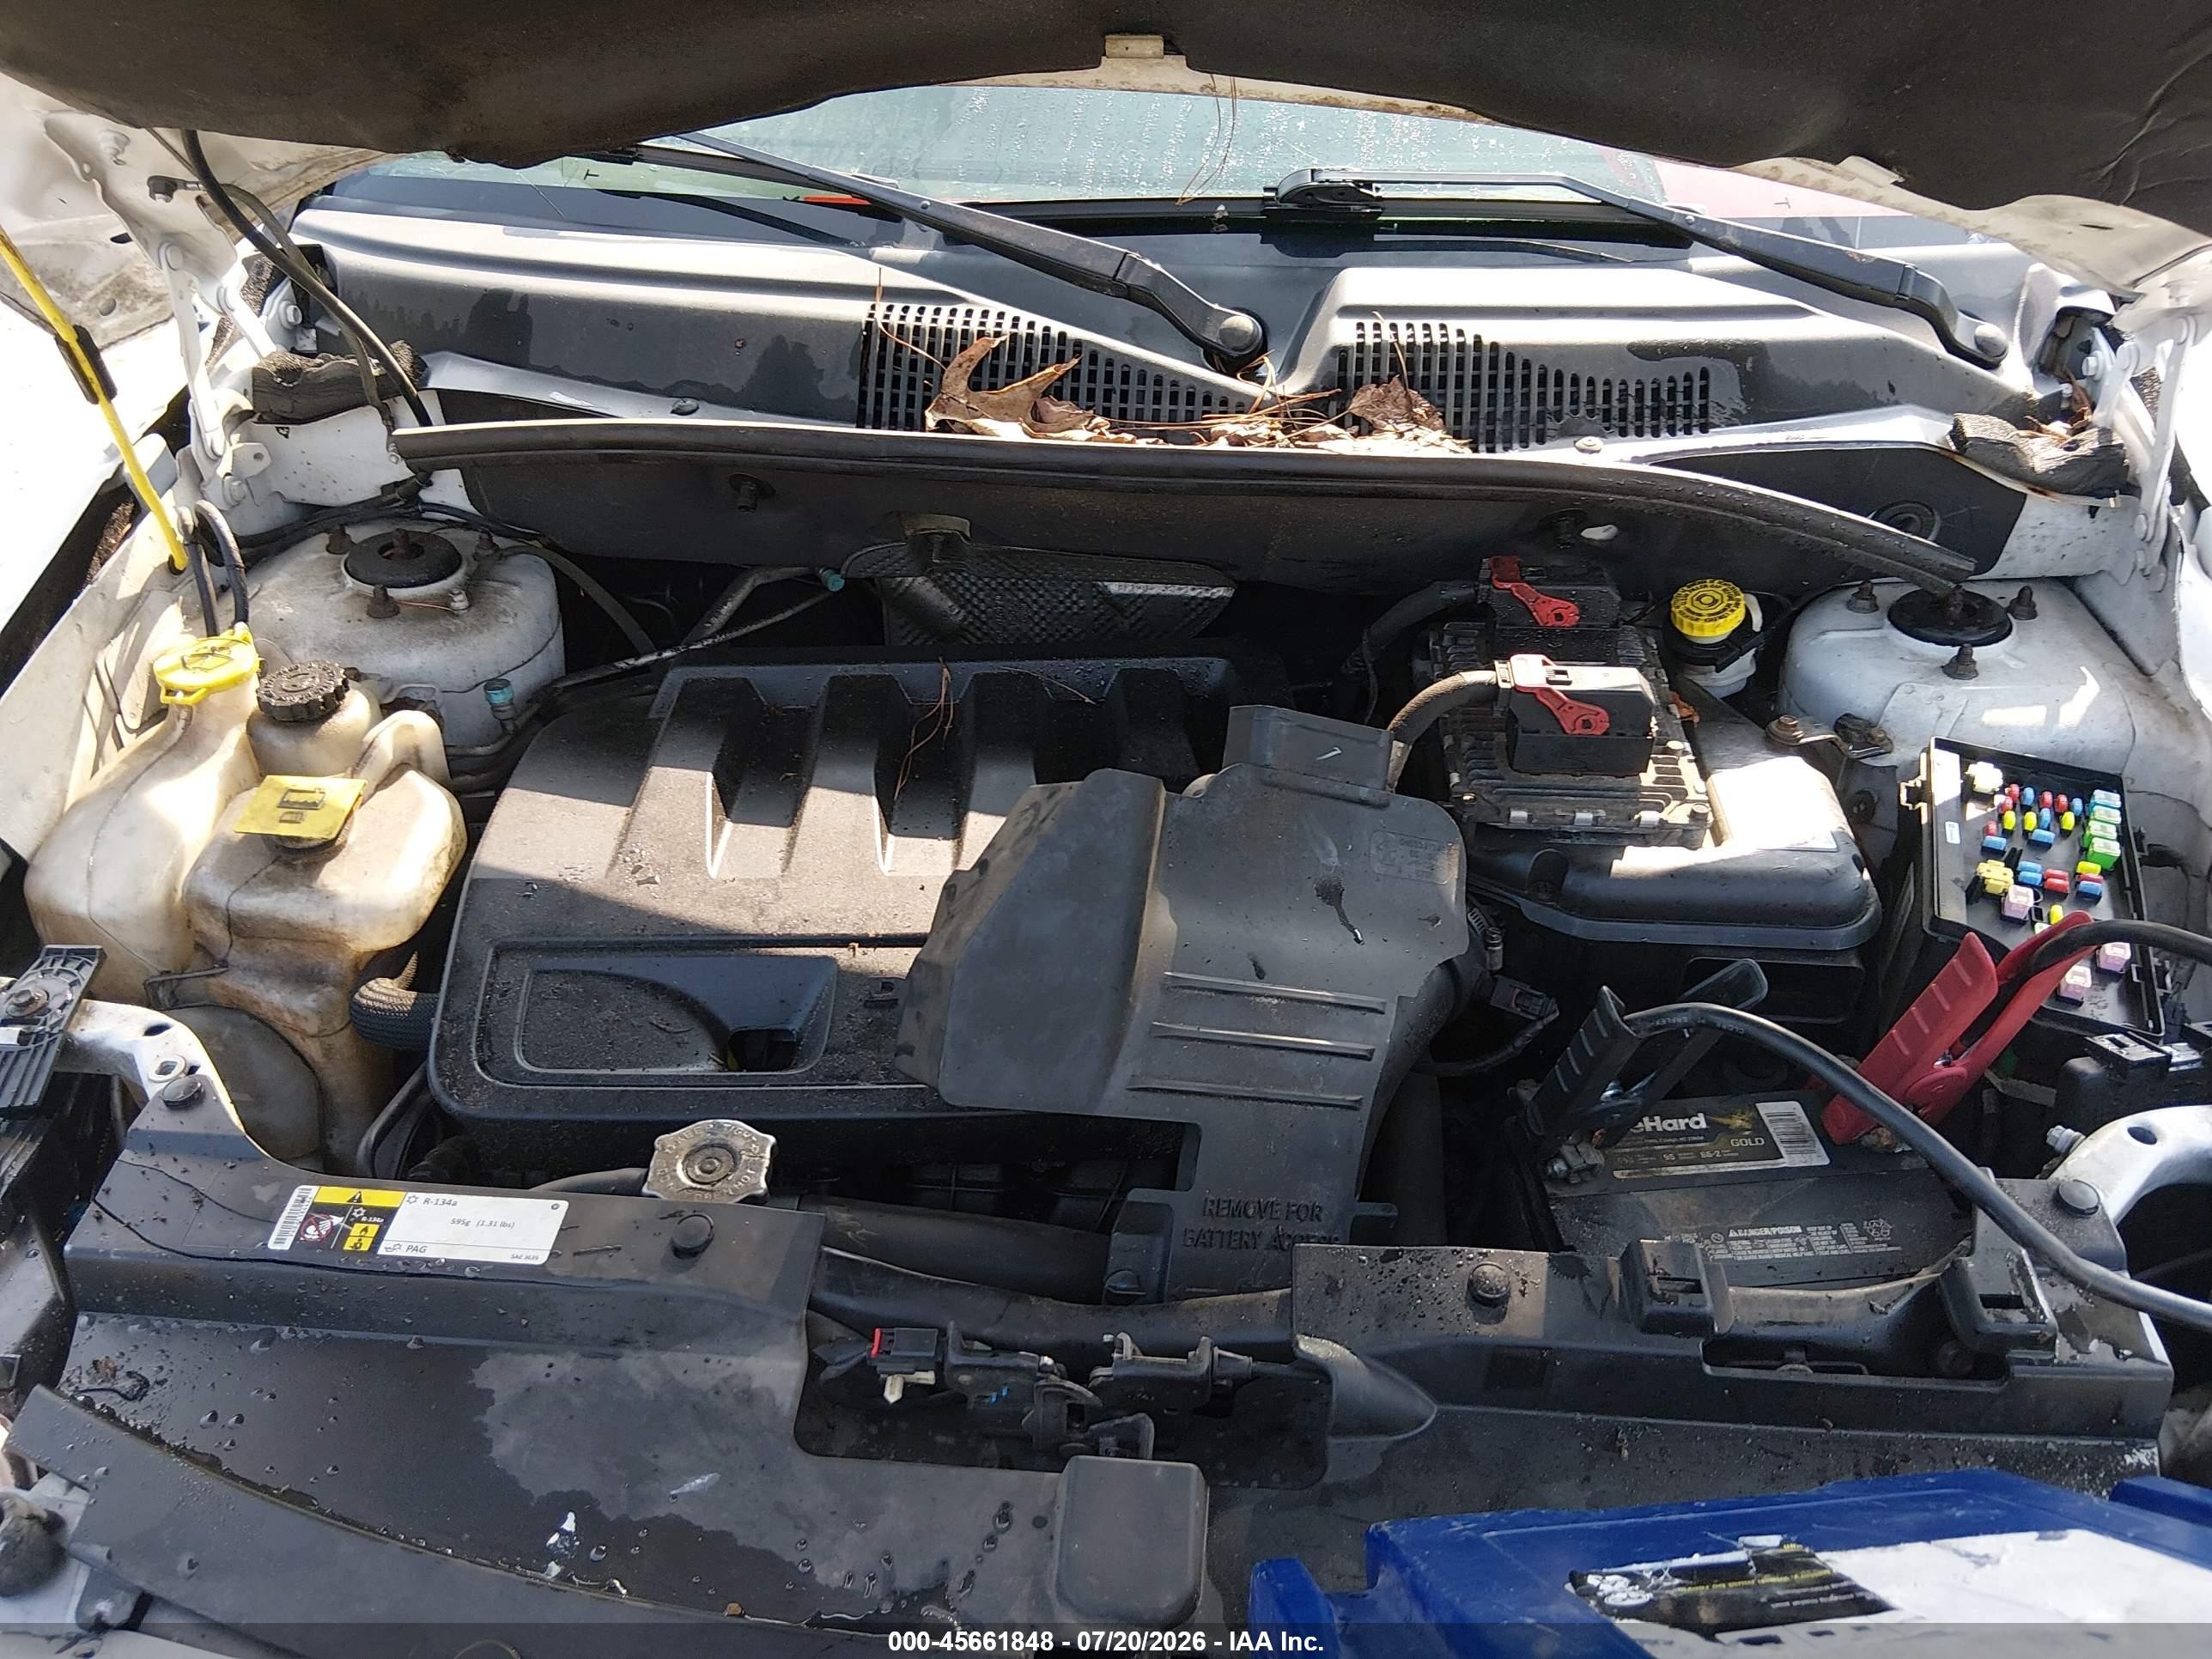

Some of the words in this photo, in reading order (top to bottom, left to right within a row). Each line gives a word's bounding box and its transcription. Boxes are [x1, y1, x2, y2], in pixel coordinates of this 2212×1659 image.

[1630, 1113, 1707, 1133] eHard
[675, 1124, 714, 1147] KEEP
[1730, 1137, 1765, 1147] GOLD
[422, 1197, 458, 1206] R-134a
[1202, 1198, 1280, 1219] REMOVE
[1285, 1200, 1323, 1223] FOR
[451, 1218, 471, 1227] 595g
[476, 1219, 497, 1228] (1.31
[499, 1221, 515, 1230] lbs)
[1182, 1227, 1263, 1251] BATTERY
[405, 1244, 428, 1254] PAG
